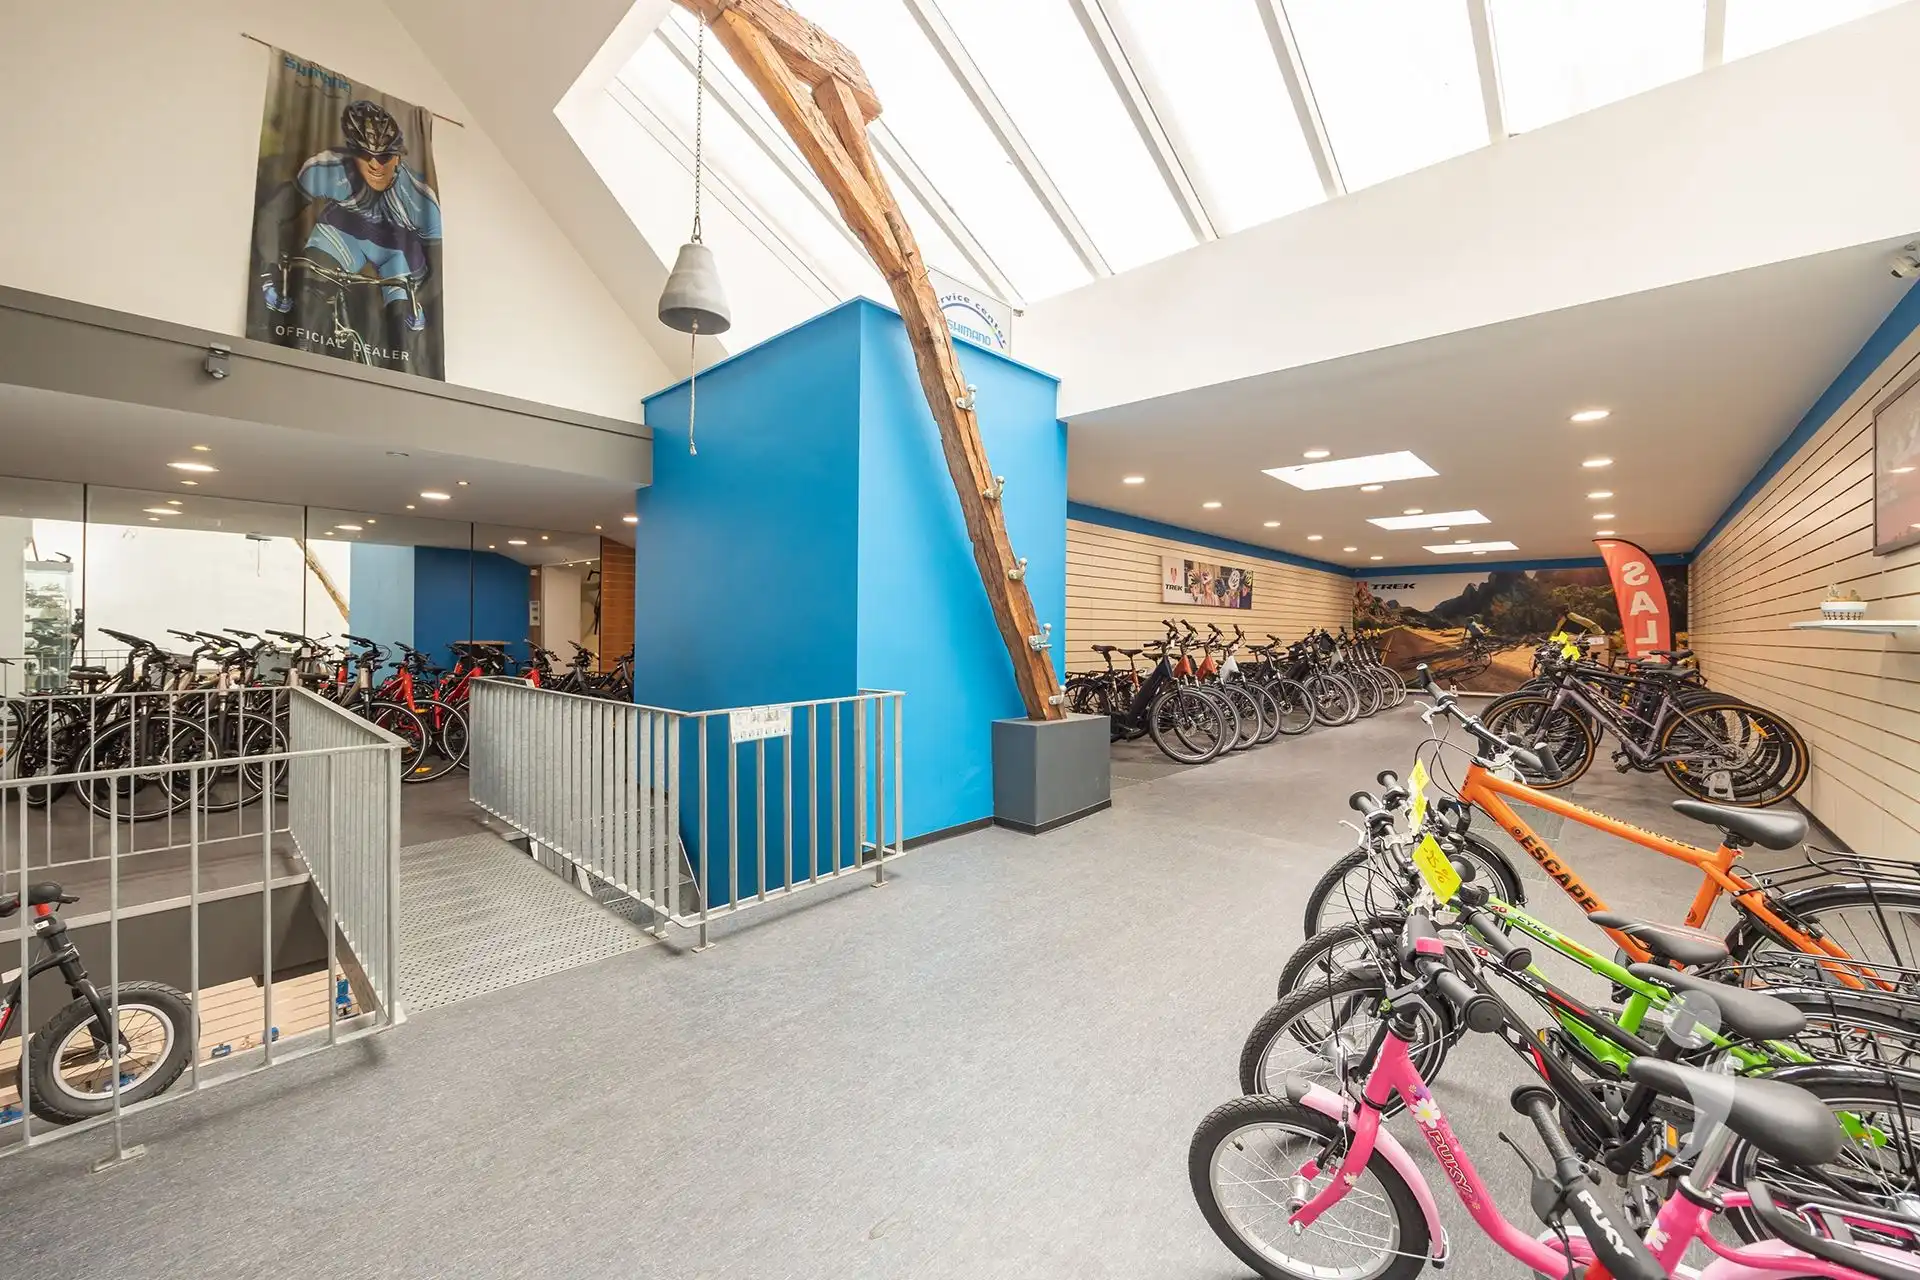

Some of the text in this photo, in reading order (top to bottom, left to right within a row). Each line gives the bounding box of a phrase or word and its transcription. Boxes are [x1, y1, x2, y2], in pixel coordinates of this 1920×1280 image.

[940, 292, 1007, 345] rvice center
[946, 318, 992, 346] SHIMANO
[275, 325, 409, 362] OFFICIAL DEALER
[1165, 583, 1183, 592] TREK
[1371, 582, 1417, 591] TREK
[1519, 834, 1599, 912] ESCAPE
[1426, 1129, 1473, 1194] PUKY
[1576, 1189, 1636, 1258] PUKY
